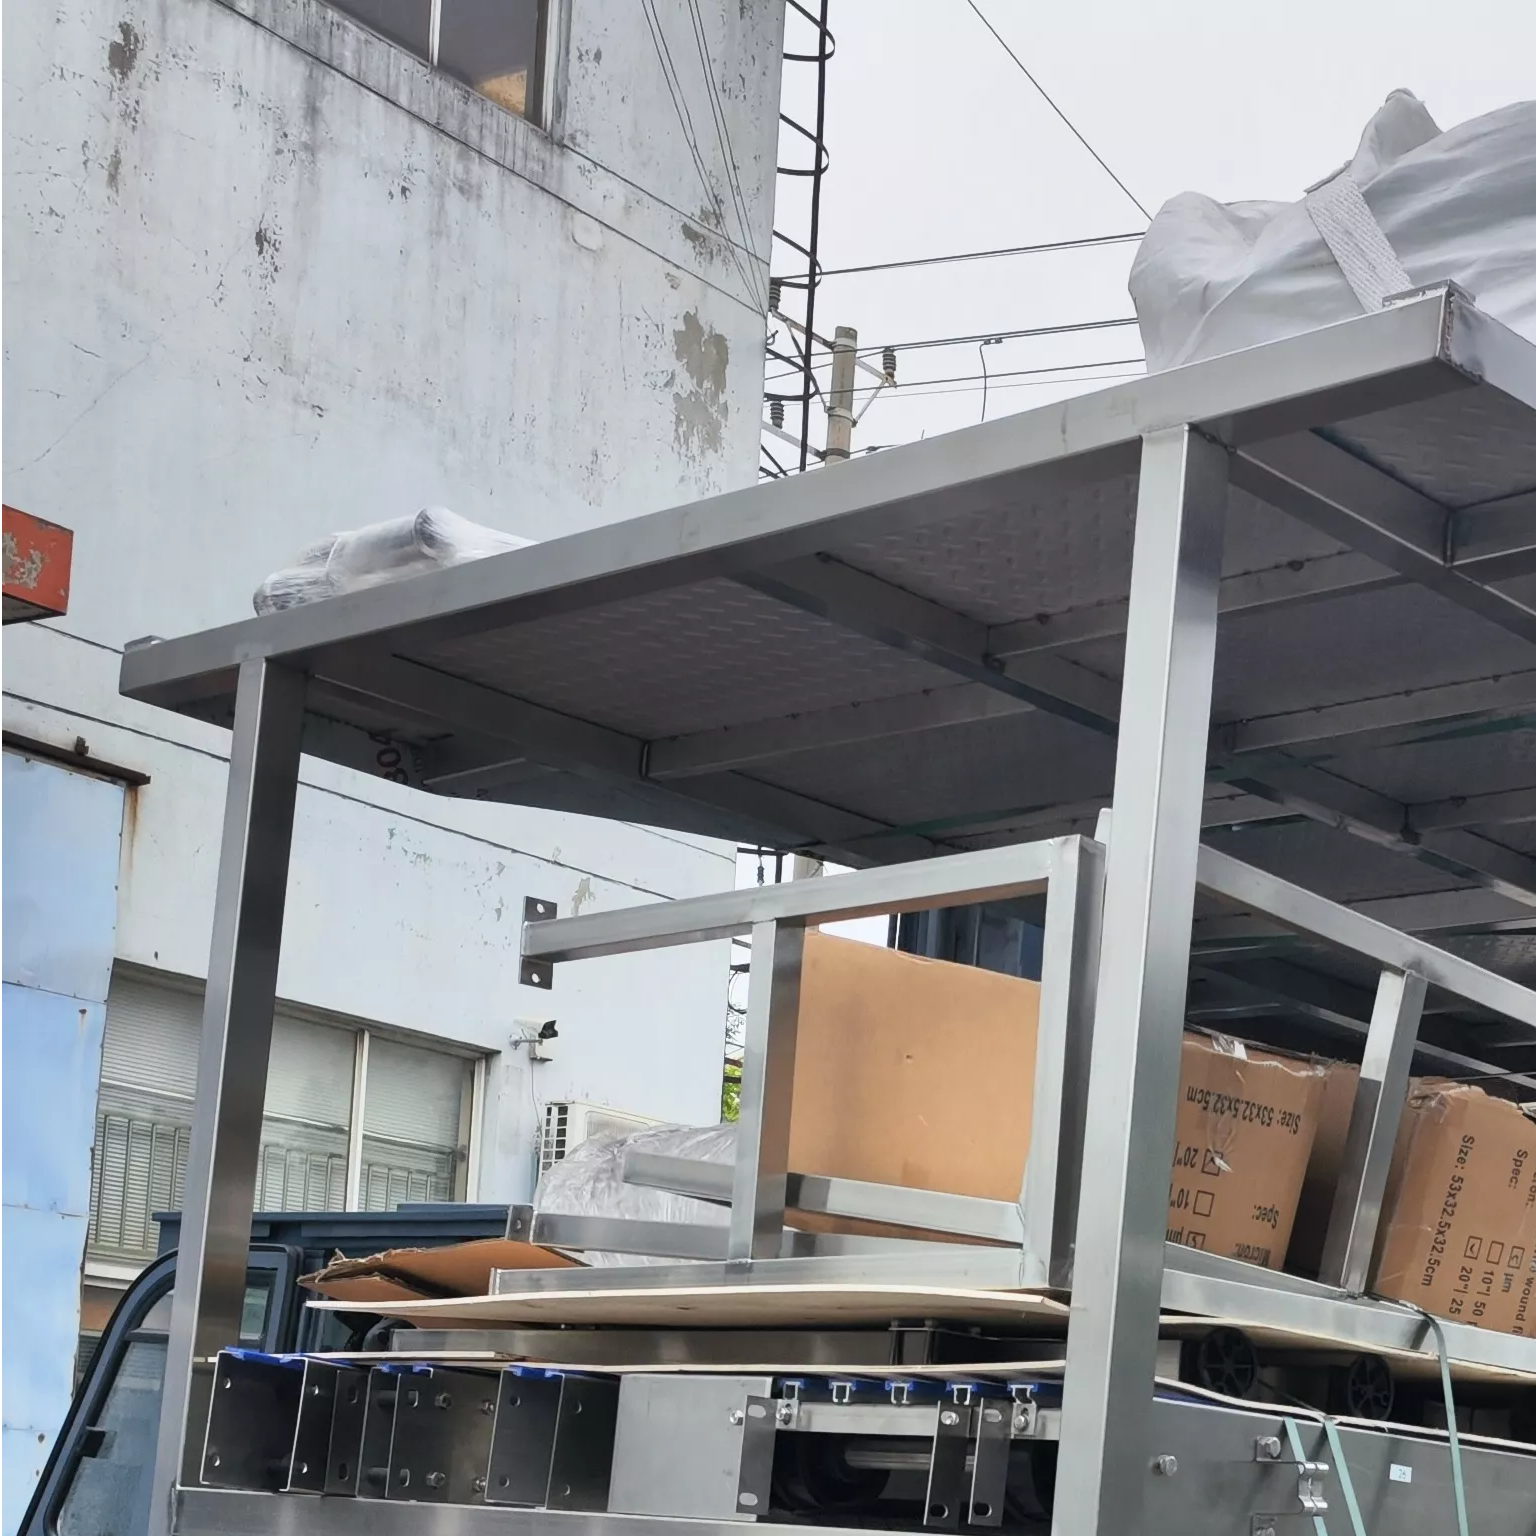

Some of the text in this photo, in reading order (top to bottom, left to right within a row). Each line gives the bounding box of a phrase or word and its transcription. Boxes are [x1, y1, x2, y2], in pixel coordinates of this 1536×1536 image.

[1508, 1149, 1528, 1189] Spec:
[1252, 1204, 1279, 1230] Spec:
[1421, 1134, 1475, 1287] Size: 53x32.5x32.5cm
[1448, 1299, 1464, 1315] 25
[1515, 1276, 1534, 1323] wound
